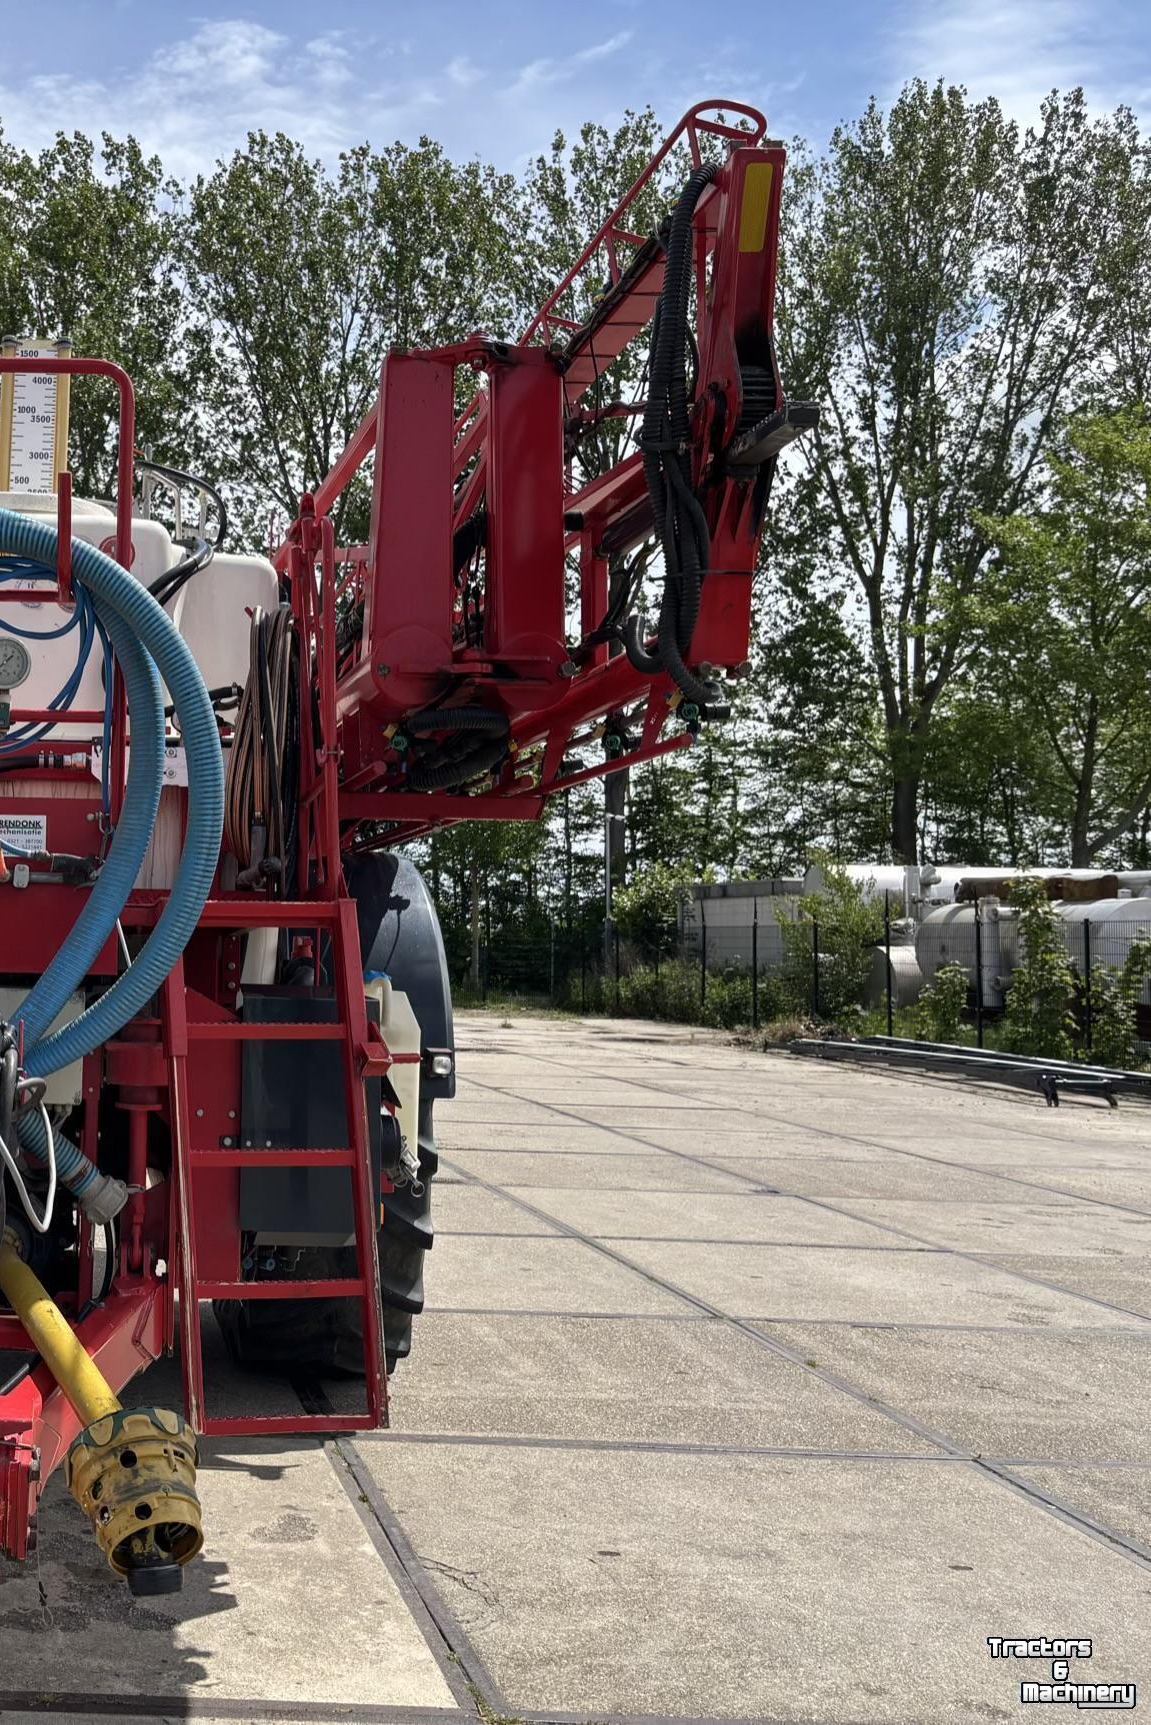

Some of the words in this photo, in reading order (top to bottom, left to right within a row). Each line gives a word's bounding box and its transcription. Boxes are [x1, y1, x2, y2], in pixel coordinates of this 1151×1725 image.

[20, 350, 39, 358] 1500
[32, 376, 53, 385] 4000
[17, 406, 36, 414] 1000
[30, 415, 51, 423] 3500
[28, 452, 49, 460] 3000
[14, 476, 30, 485] 500
